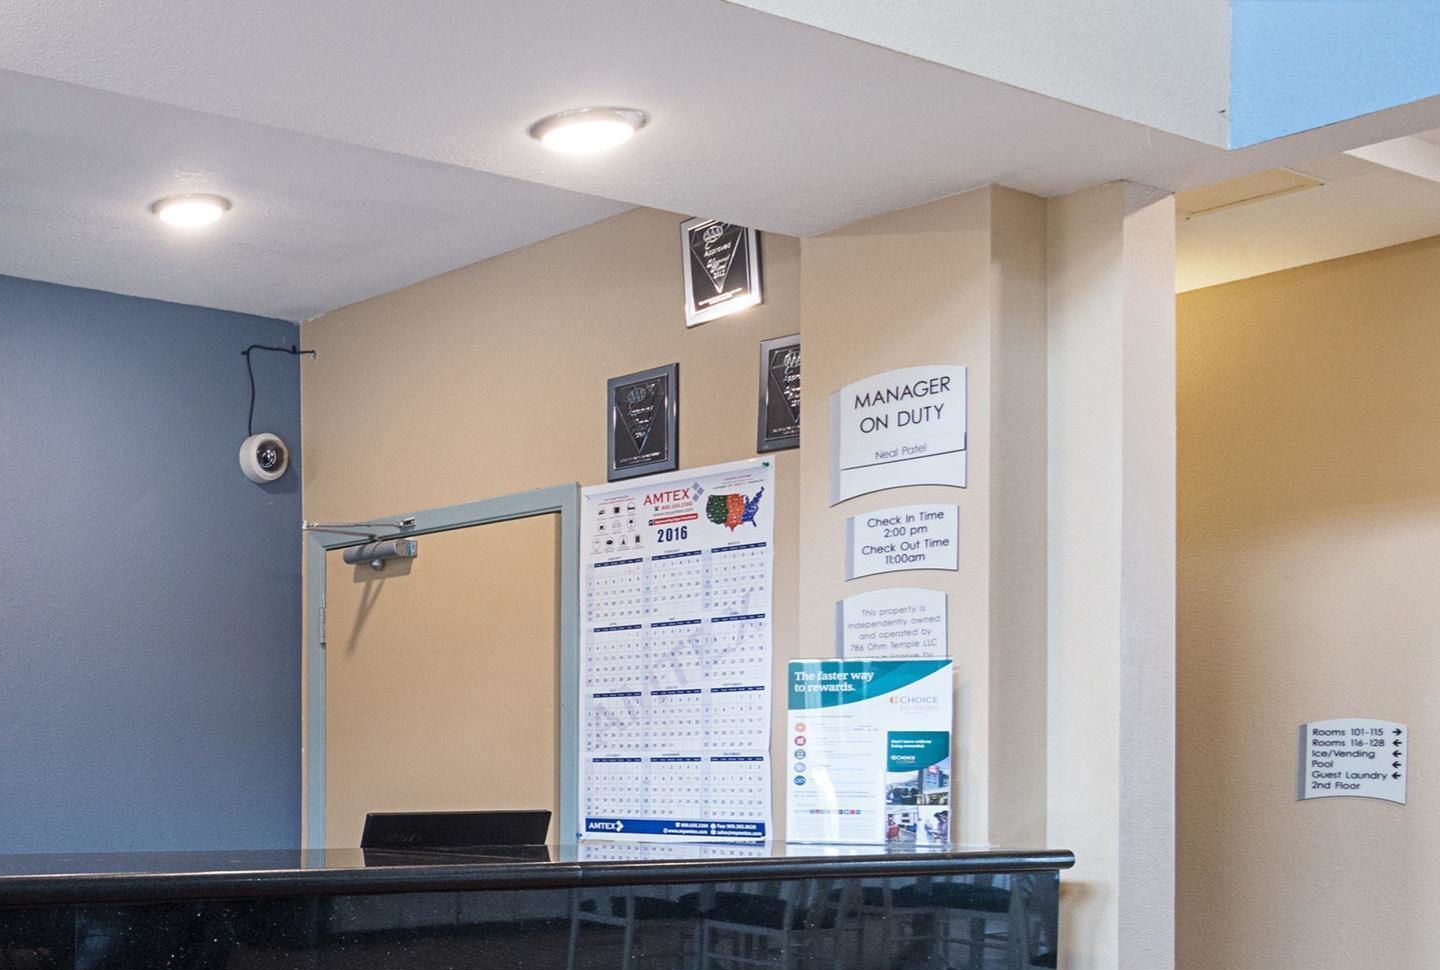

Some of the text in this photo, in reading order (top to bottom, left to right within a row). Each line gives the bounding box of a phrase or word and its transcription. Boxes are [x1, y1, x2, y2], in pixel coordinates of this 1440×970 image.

[854, 375, 951, 410] MANAGER
[859, 403, 945, 434] ON DUTY
[875, 442, 928, 460] Neal Patel
[643, 487, 690, 506] AMTEX
[867, 511, 945, 528] Check In Time
[657, 525, 688, 543] 2016
[883, 525, 928, 538] 2:00 pm
[861, 538, 950, 555] Check Out Time
[885, 553, 926, 564] 11:00am
[861, 608, 876, 617] This
[878, 605, 917, 617] property
[847, 615, 941, 630] independently owned
[858, 627, 932, 640] and operated by
[890, 640, 920, 651] Temple
[923, 638, 938, 647] LLC
[794, 671, 875, 683] The faster way
[794, 682, 856, 693] to rewards.
[899, 696, 938, 704] CHOICE
[1312, 728, 1346, 736] Rooms
[1312, 739, 1346, 747] Rooms
[1311, 750, 1376, 759] Ice/Vending
[1311, 760, 1334, 768] Pool
[1311, 770, 1388, 780] Guest Laundry
[1311, 781, 1361, 789] 2nd Floor
[588, 821, 616, 831] AMTEX
